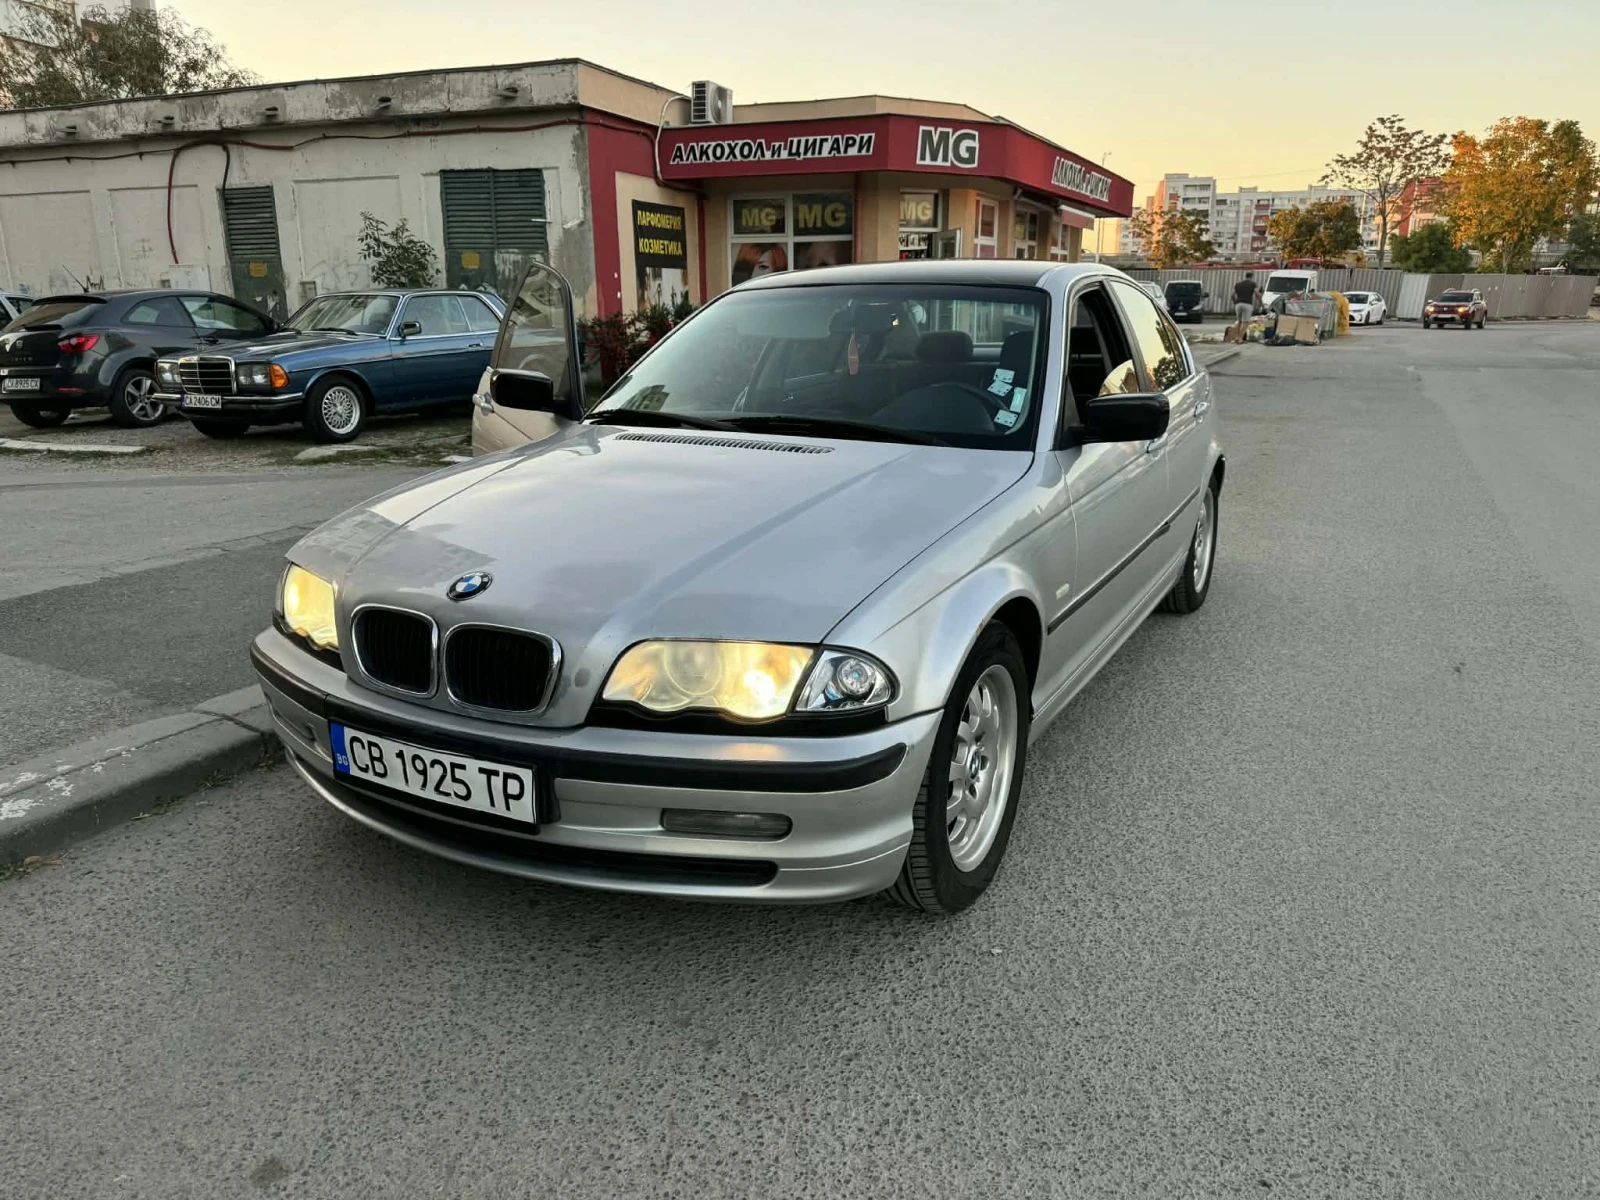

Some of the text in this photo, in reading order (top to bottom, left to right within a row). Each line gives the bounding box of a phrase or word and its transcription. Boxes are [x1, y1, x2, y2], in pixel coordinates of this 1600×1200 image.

[670, 133, 875, 164] АЛКОХОЛ и ЦИГАРИ
[916, 126, 979, 168] MG
[637, 210, 682, 231] ПАРФЮМЕРИЯ
[742, 207, 776, 226] MG
[798, 202, 846, 229] MG
[900, 200, 933, 220] MG
[638, 237, 683, 256] КОЗМЕТИКА
[349, 736, 525, 811] CB 1925 TP
